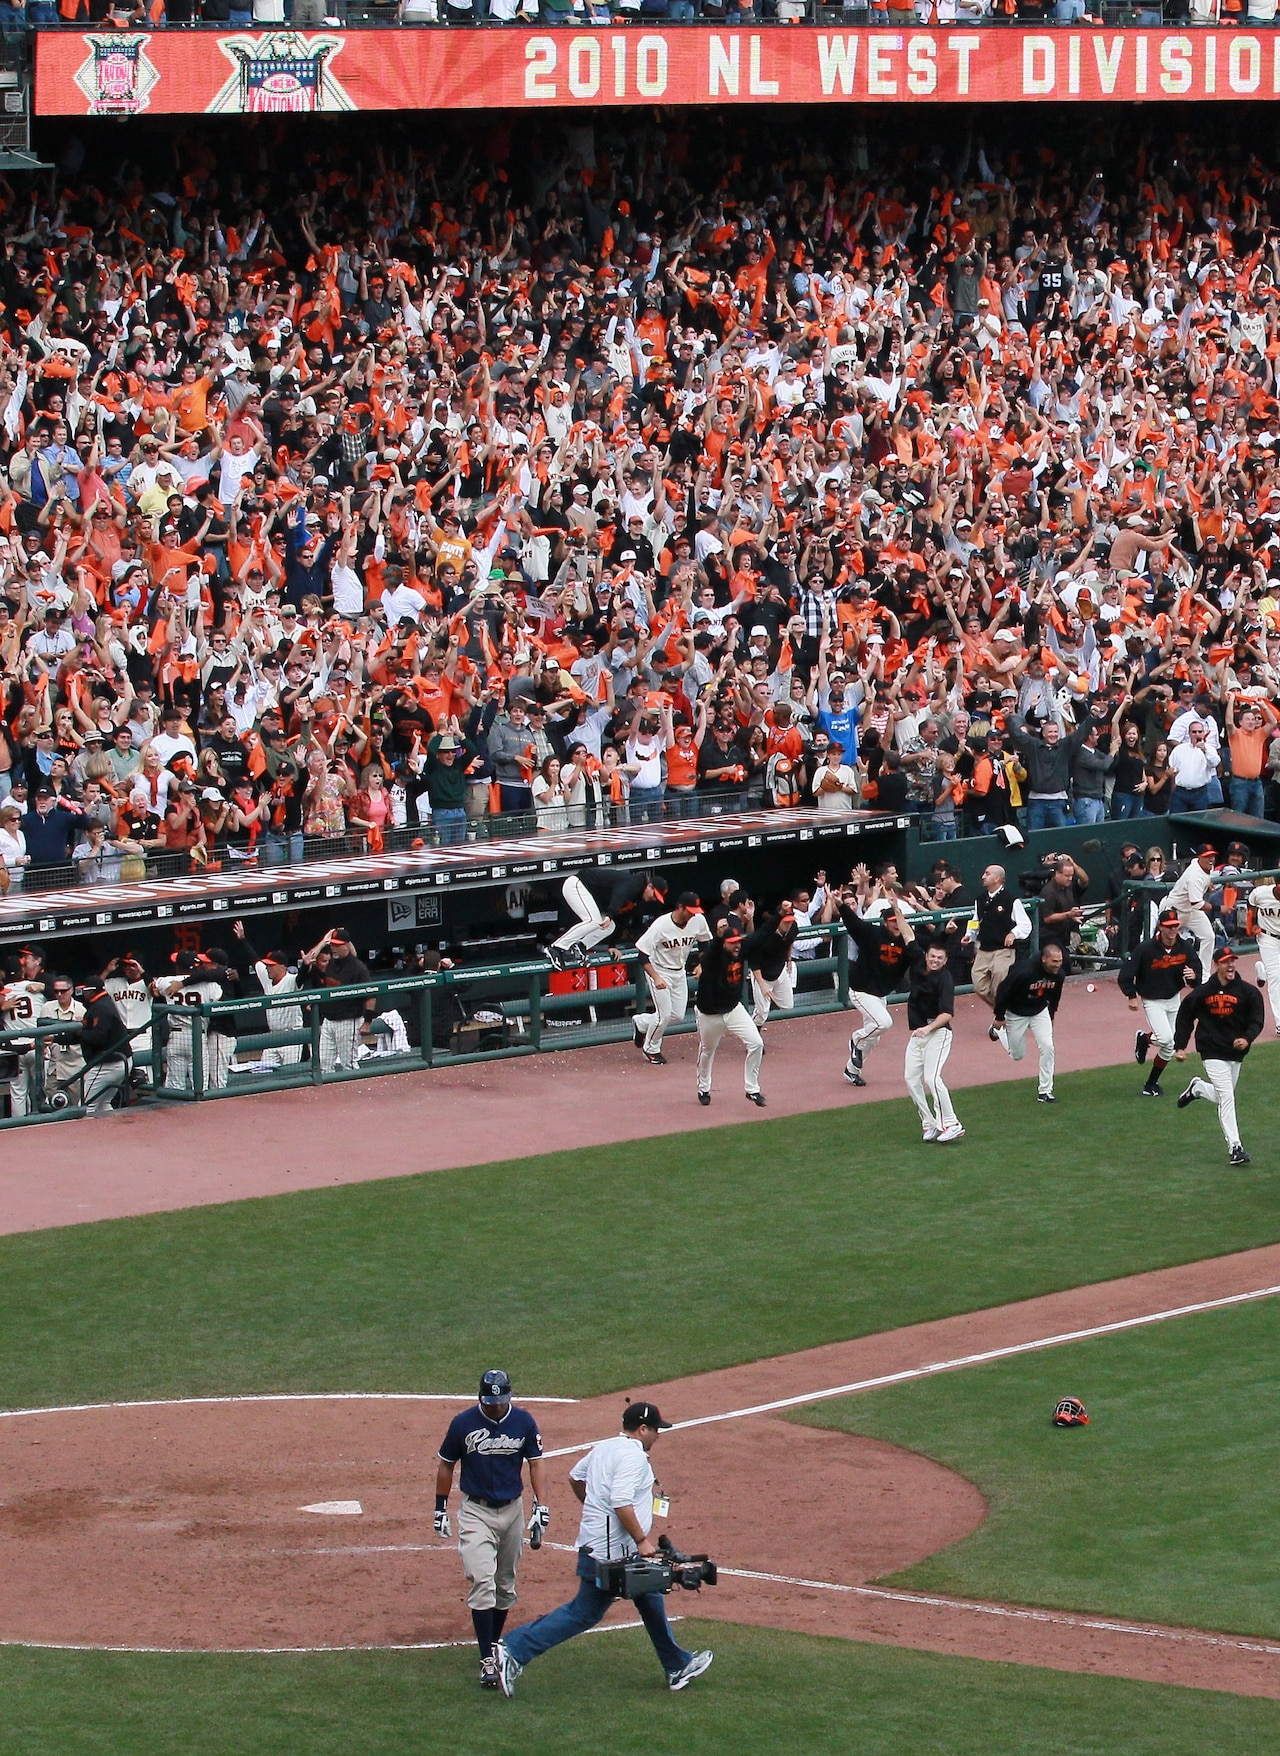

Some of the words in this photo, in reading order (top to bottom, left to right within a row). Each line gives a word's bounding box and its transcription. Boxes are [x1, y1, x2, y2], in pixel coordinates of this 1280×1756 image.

[525, 36, 668, 98] 2010
[709, 35, 779, 96] NL
[818, 35, 980, 95] WEST
[1042, 273, 1061, 288] 35
[865, 821, 893, 829] neweracap.com
[819, 827, 841, 835] sfgiants.com
[767, 832, 796, 841] neweracap.com
[720, 839, 744, 847] sfgiants.com
[666, 845, 695, 854] neweracap.com
[618, 851, 642, 859] sfgiants.com
[562, 857, 593, 866] neweracap.com
[513, 864, 538, 873] sfgiants.com
[456, 870, 487, 879] neweracap.com
[405, 877, 430, 886] sfgiants.com
[347, 882, 379, 891] neweracap.com
[294, 890, 320, 899] sfgiants.com
[0, 889, 157, 914] GIAN
[234, 896, 267, 905] neweracap.com
[418, 896, 438, 908] NEW
[180, 902, 206, 912] sfgiants.com
[118, 910, 152, 918] neweracap.com
[418, 907, 438, 919] ERA
[63, 917, 89, 927] sfgiants.com
[113, 990, 146, 1002] GIANTS
[465, 1427, 526, 1455] Padres
